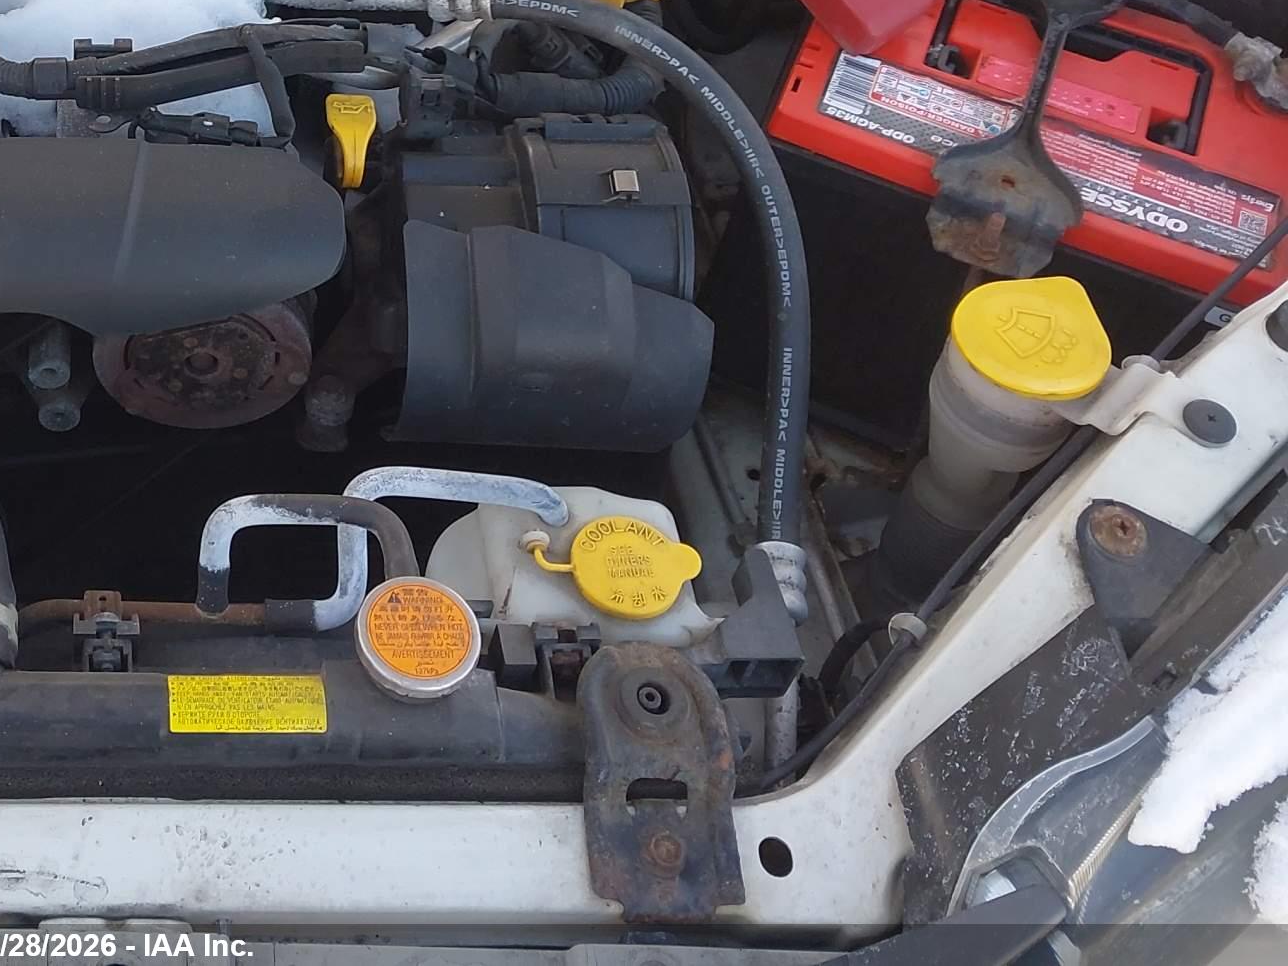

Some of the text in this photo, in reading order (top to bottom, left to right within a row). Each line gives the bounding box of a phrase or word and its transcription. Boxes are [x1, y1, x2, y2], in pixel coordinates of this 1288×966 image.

[824, 106, 916, 145] ODP-AGM35
[1080, 187, 1189, 234] ODYSSE
[1083, 181, 1165, 212] BATTERY
[777, 347, 793, 442] INNER>PA<
[580, 520, 666, 551] COOLANT
[610, 545, 633, 555] SEE
[607, 567, 655, 579] MANUAL
[391, 649, 455, 659] AVERTISSEMENT
